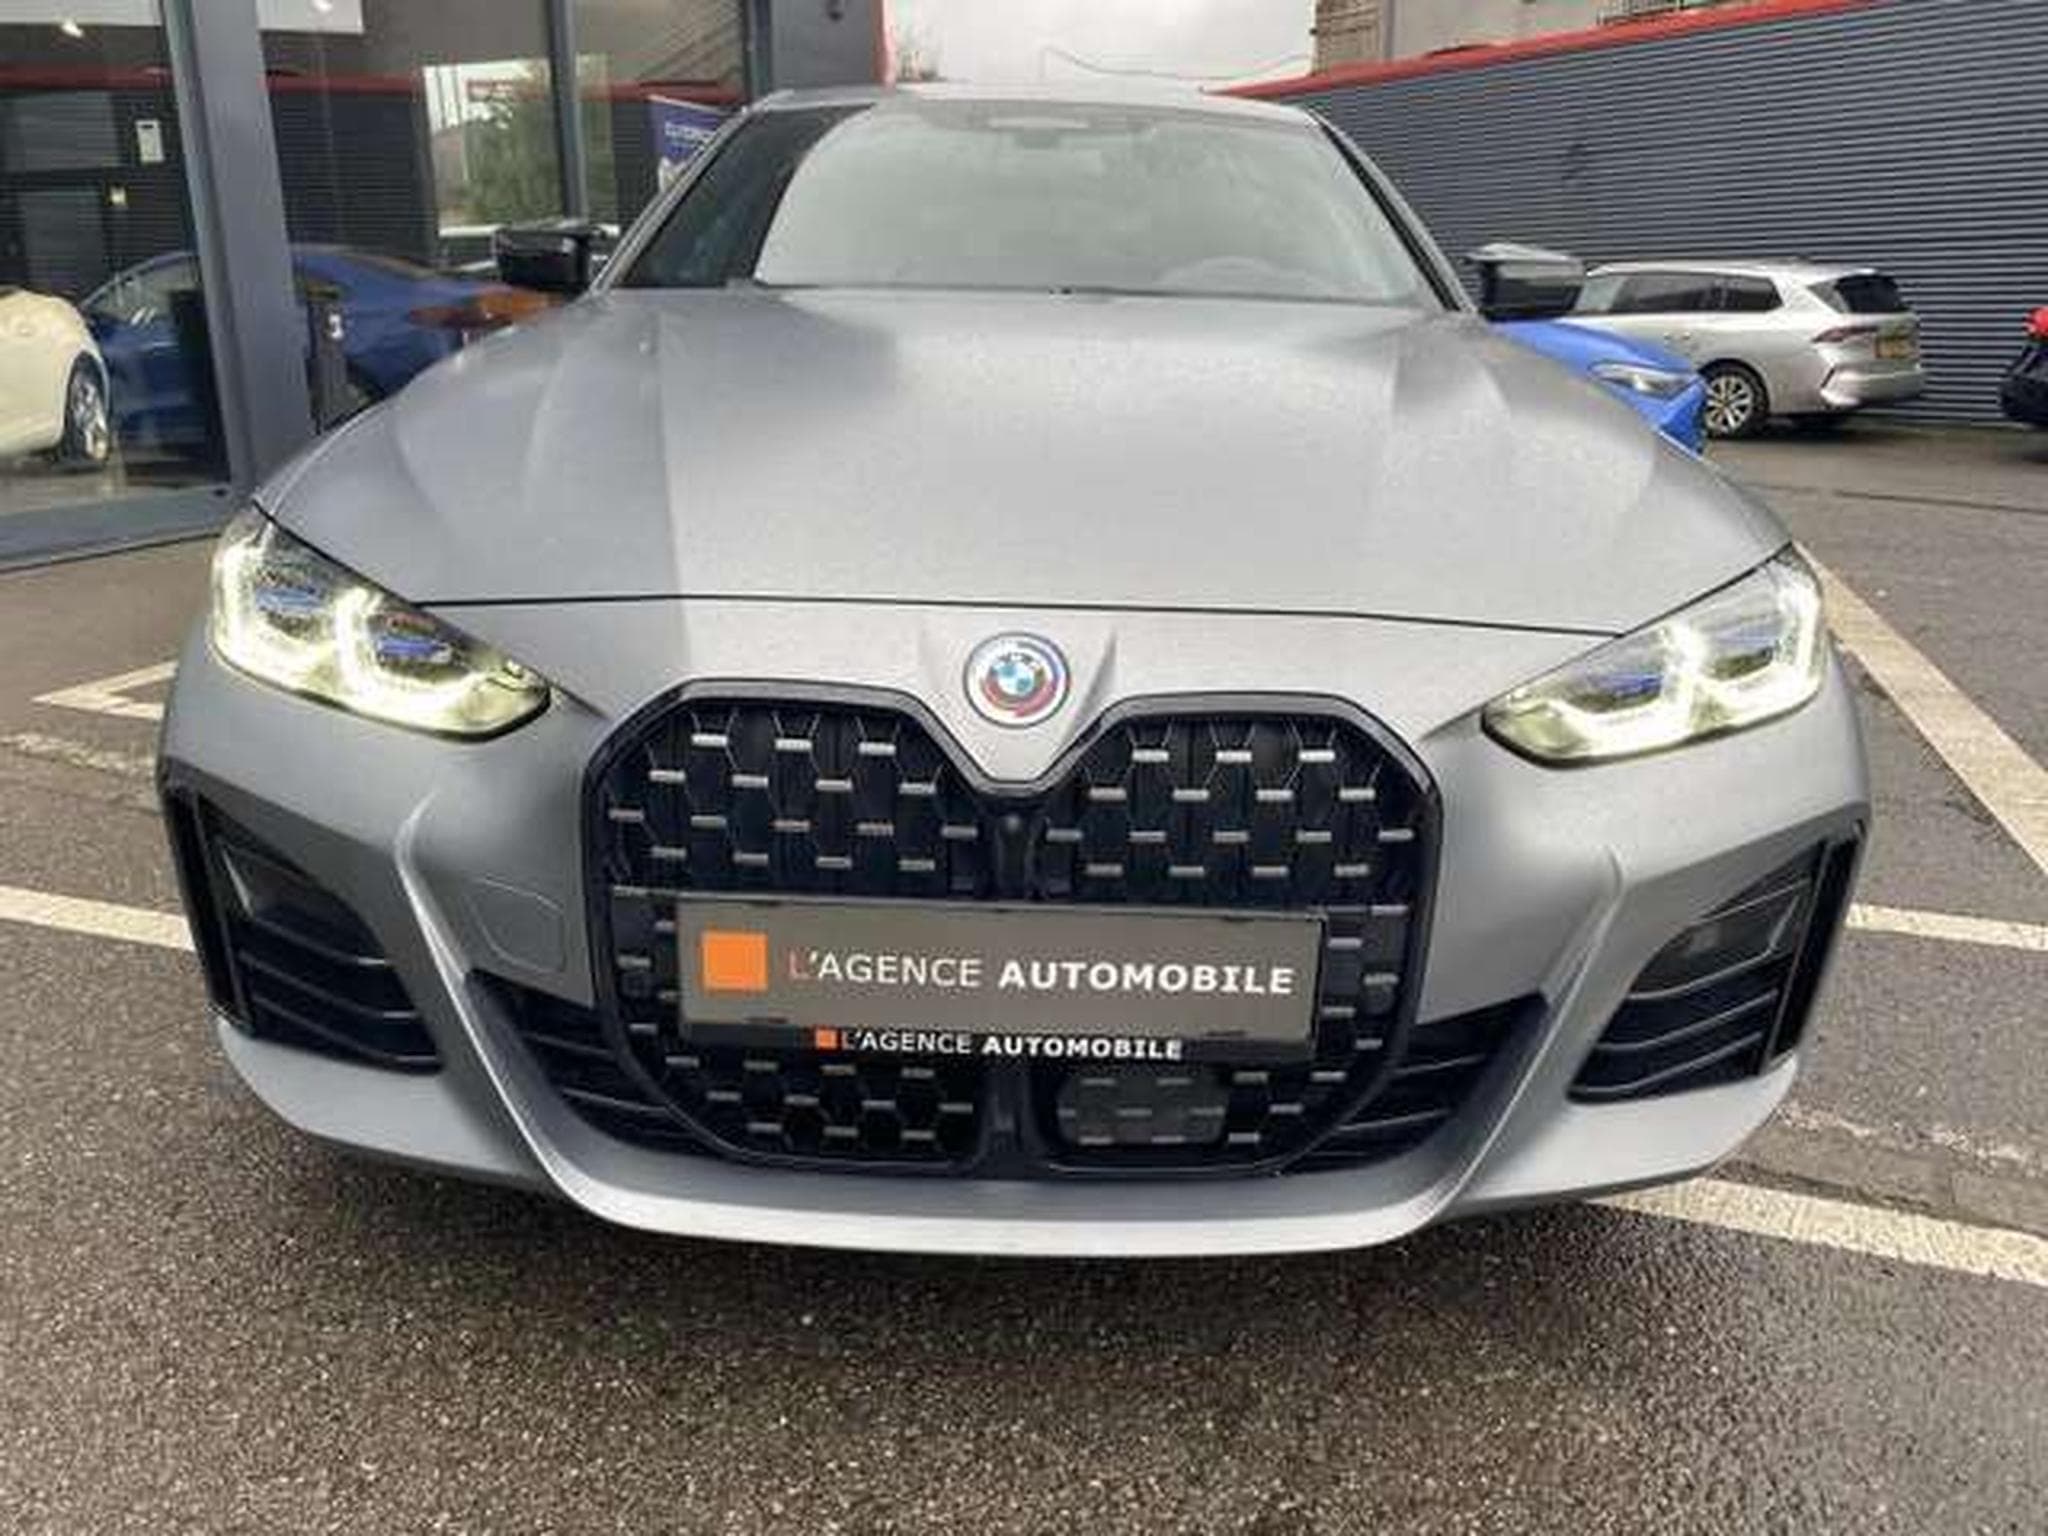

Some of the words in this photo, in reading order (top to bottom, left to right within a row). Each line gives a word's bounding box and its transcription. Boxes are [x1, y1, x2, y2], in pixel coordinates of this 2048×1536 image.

[788, 950, 982, 988] L'AGENCE
[998, 958, 1294, 995] AUTOMOBILE
[841, 1030, 972, 1054] L'AGENCE
[982, 1035, 1183, 1060] AUTOMOBILE
